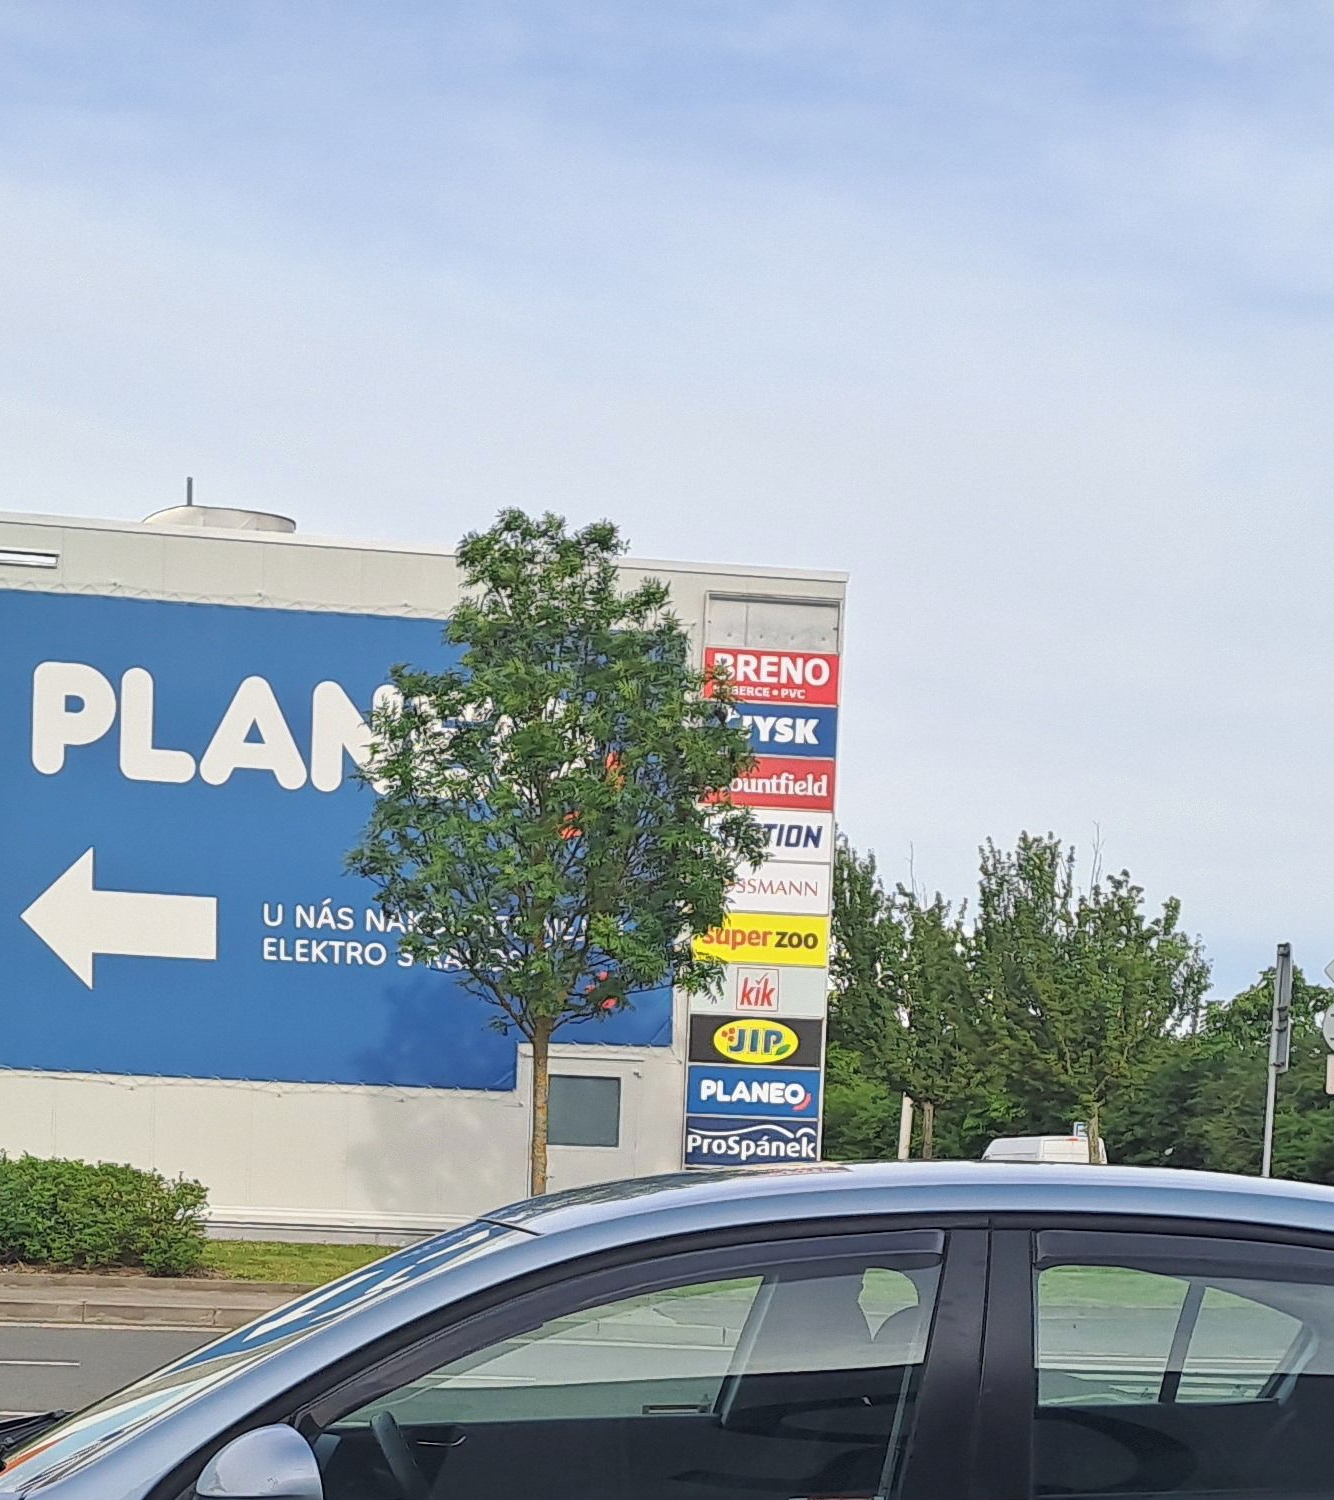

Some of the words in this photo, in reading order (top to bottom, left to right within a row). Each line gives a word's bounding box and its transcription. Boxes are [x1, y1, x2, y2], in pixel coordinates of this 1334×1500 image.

[713, 652, 830, 687] BRENO
[713, 684, 771, 698] BERCE
[780, 688, 806, 700] PVC
[730, 772, 829, 798] ountfield
[747, 822, 824, 849] TION
[724, 877, 819, 897] SSMANN
[262, 902, 284, 928] U
[295, 897, 354, 932] NÁS
[262, 937, 387, 967] ELEKTRO
[727, 1027, 784, 1056] JIP
[700, 1079, 806, 1105] PLANEO
[686, 1134, 817, 1161] ProSpánek
